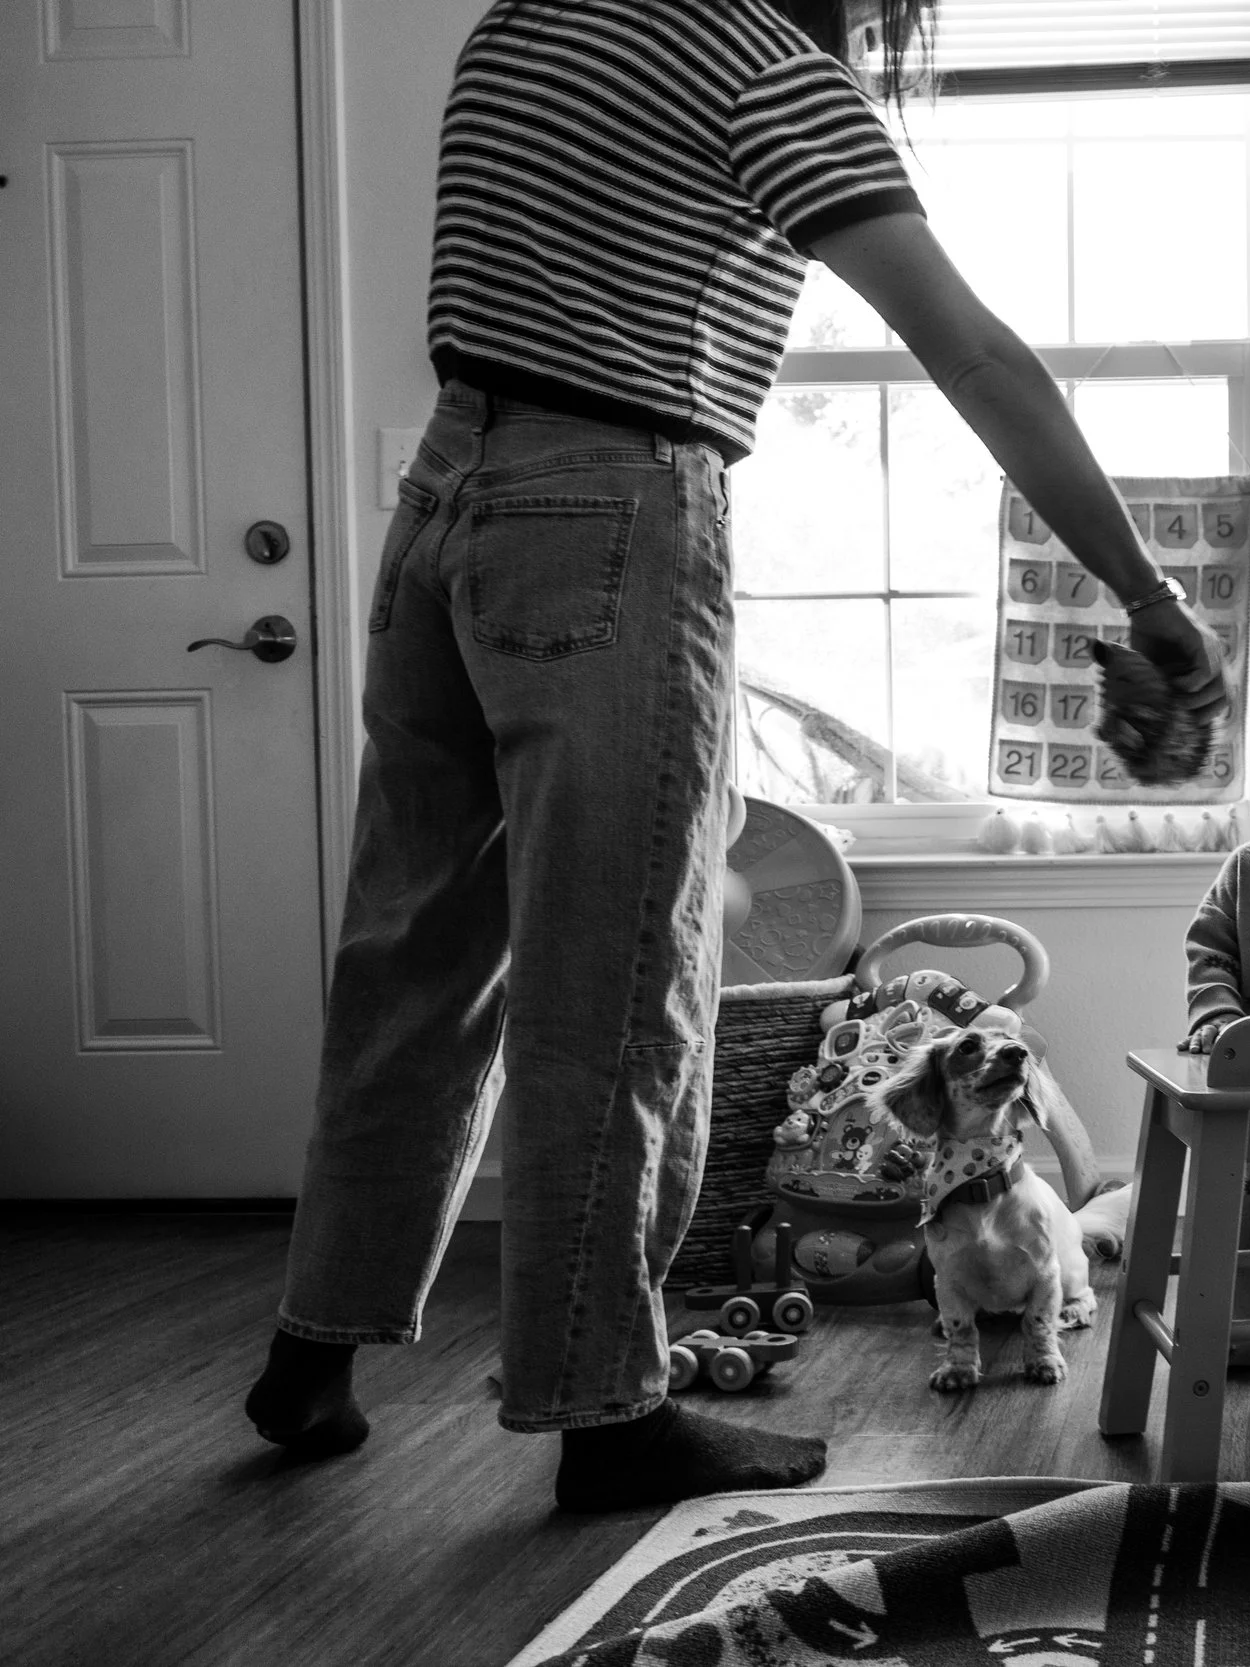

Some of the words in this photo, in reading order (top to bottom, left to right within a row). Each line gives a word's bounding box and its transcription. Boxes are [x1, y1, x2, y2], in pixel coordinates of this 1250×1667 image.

[1023, 511, 1034, 535] 1
[1167, 514, 1187, 540] 4
[1217, 513, 1234, 538] 5
[1021, 569, 1039, 593] 6
[1068, 572, 1087, 598] 7
[1208, 573, 1234, 599] 10
[1013, 630, 1037, 657] 11
[1061, 634, 1091, 660] 12
[1009, 692, 1037, 718] 16
[1058, 694, 1088, 720] 17
[1004, 750, 1036, 777] 21
[1051, 754, 1088, 779] 22
